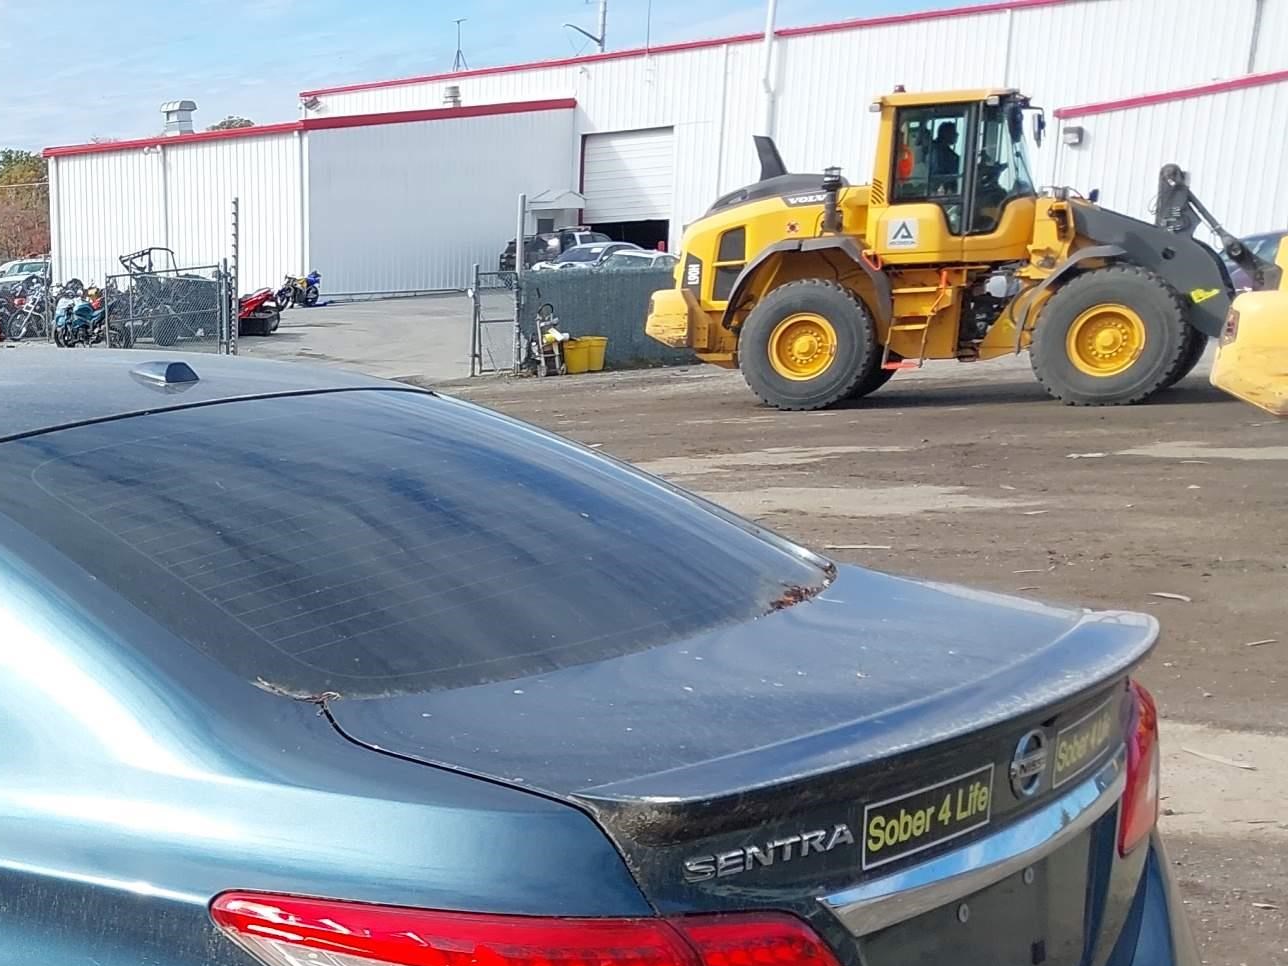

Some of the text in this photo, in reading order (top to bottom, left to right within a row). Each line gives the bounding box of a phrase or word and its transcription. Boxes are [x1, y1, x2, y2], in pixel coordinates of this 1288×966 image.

[788, 194, 829, 204] VOLV
[687, 263, 701, 285] L90H
[867, 782, 988, 851] Sober 4 Life
[683, 823, 854, 883] SENTRA
